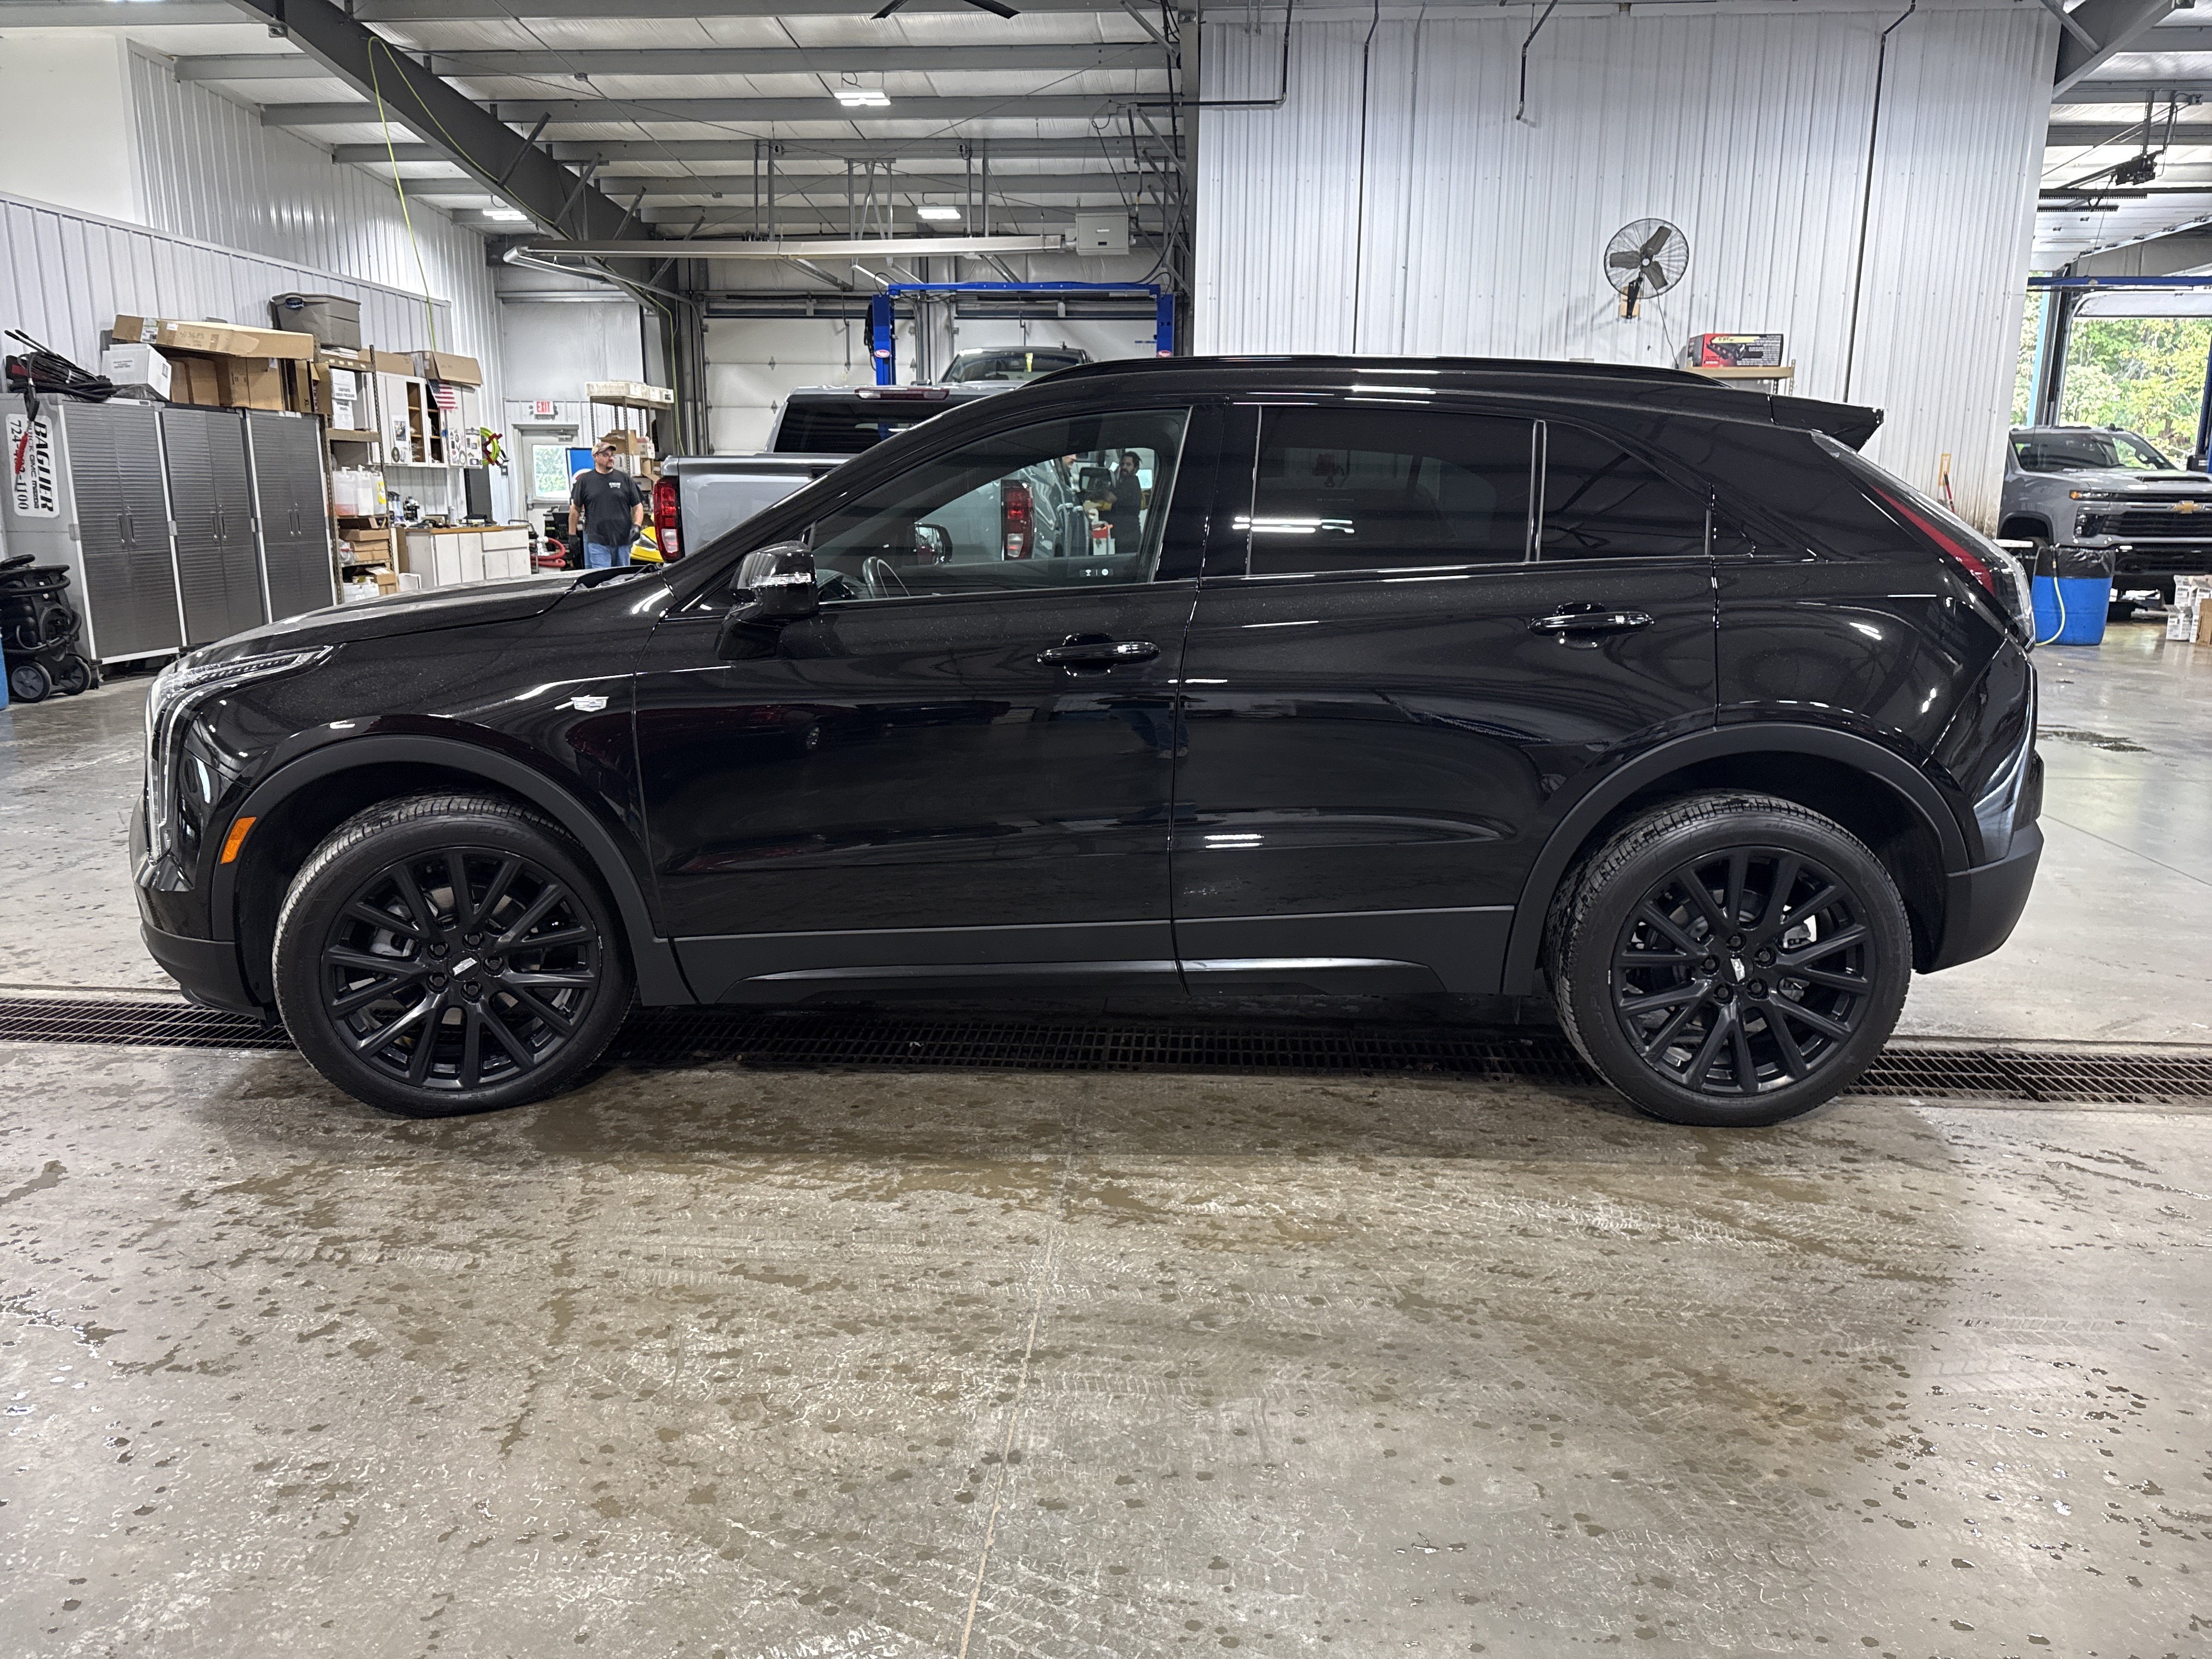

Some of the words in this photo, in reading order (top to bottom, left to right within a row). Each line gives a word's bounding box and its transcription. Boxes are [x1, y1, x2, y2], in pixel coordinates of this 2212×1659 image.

[537, 401, 550, 413] EXIT
[10, 420, 29, 510] 724-2-1100
[34, 421, 54, 512] BAGLIER
